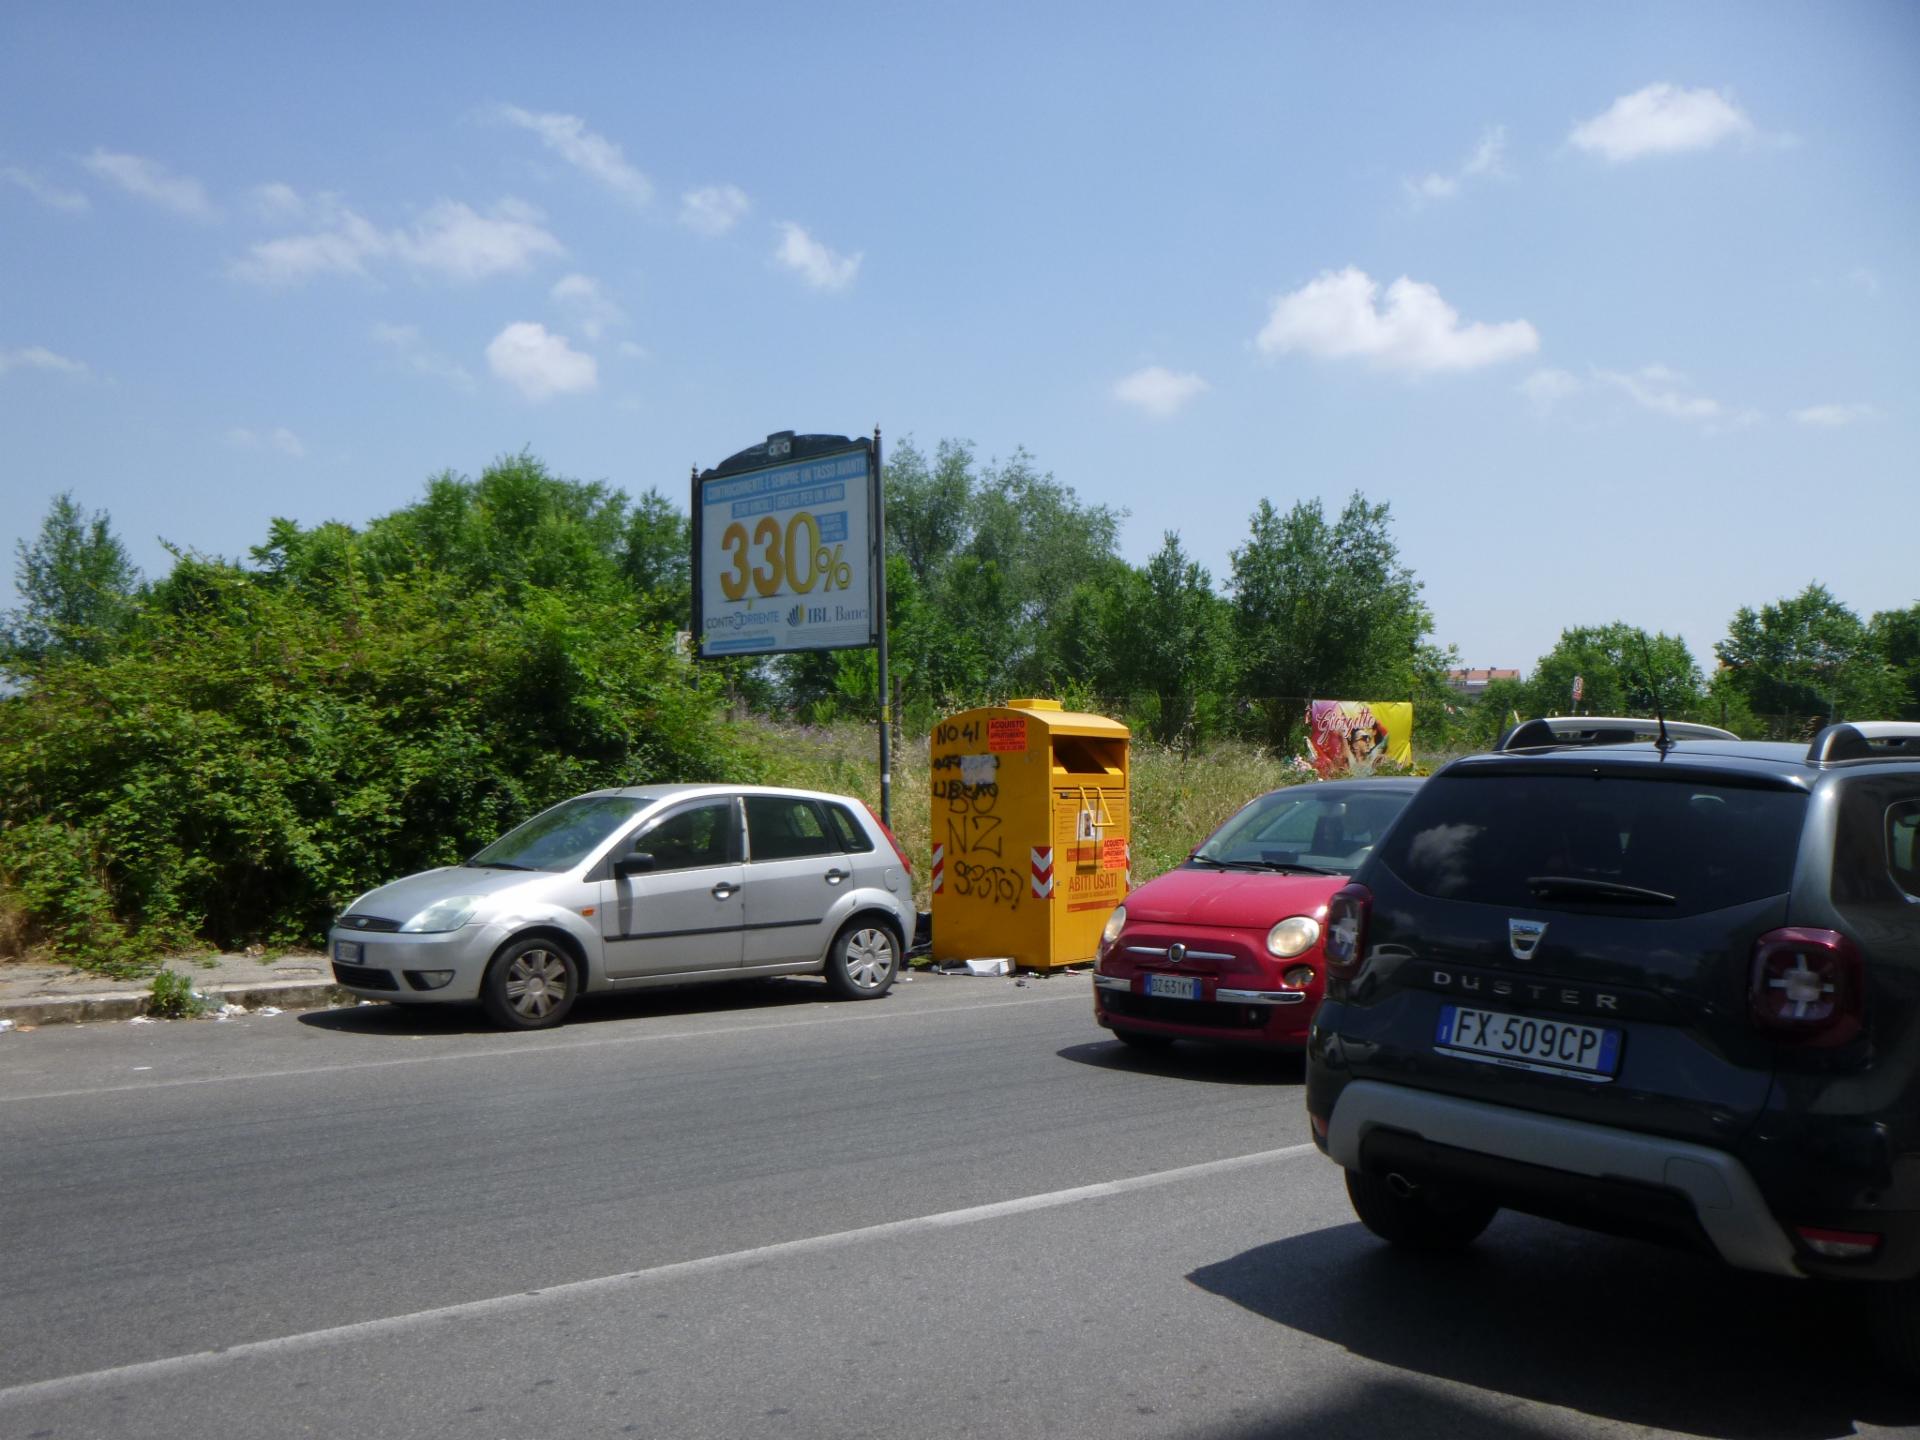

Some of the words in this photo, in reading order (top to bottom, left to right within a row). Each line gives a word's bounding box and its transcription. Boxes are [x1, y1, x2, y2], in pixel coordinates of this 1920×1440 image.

[808, 607, 832, 624] IBL
[1068, 875, 1091, 892] ABITI
[1093, 872, 1117, 890] USATI
[1433, 971, 1617, 1010] DUSTER
